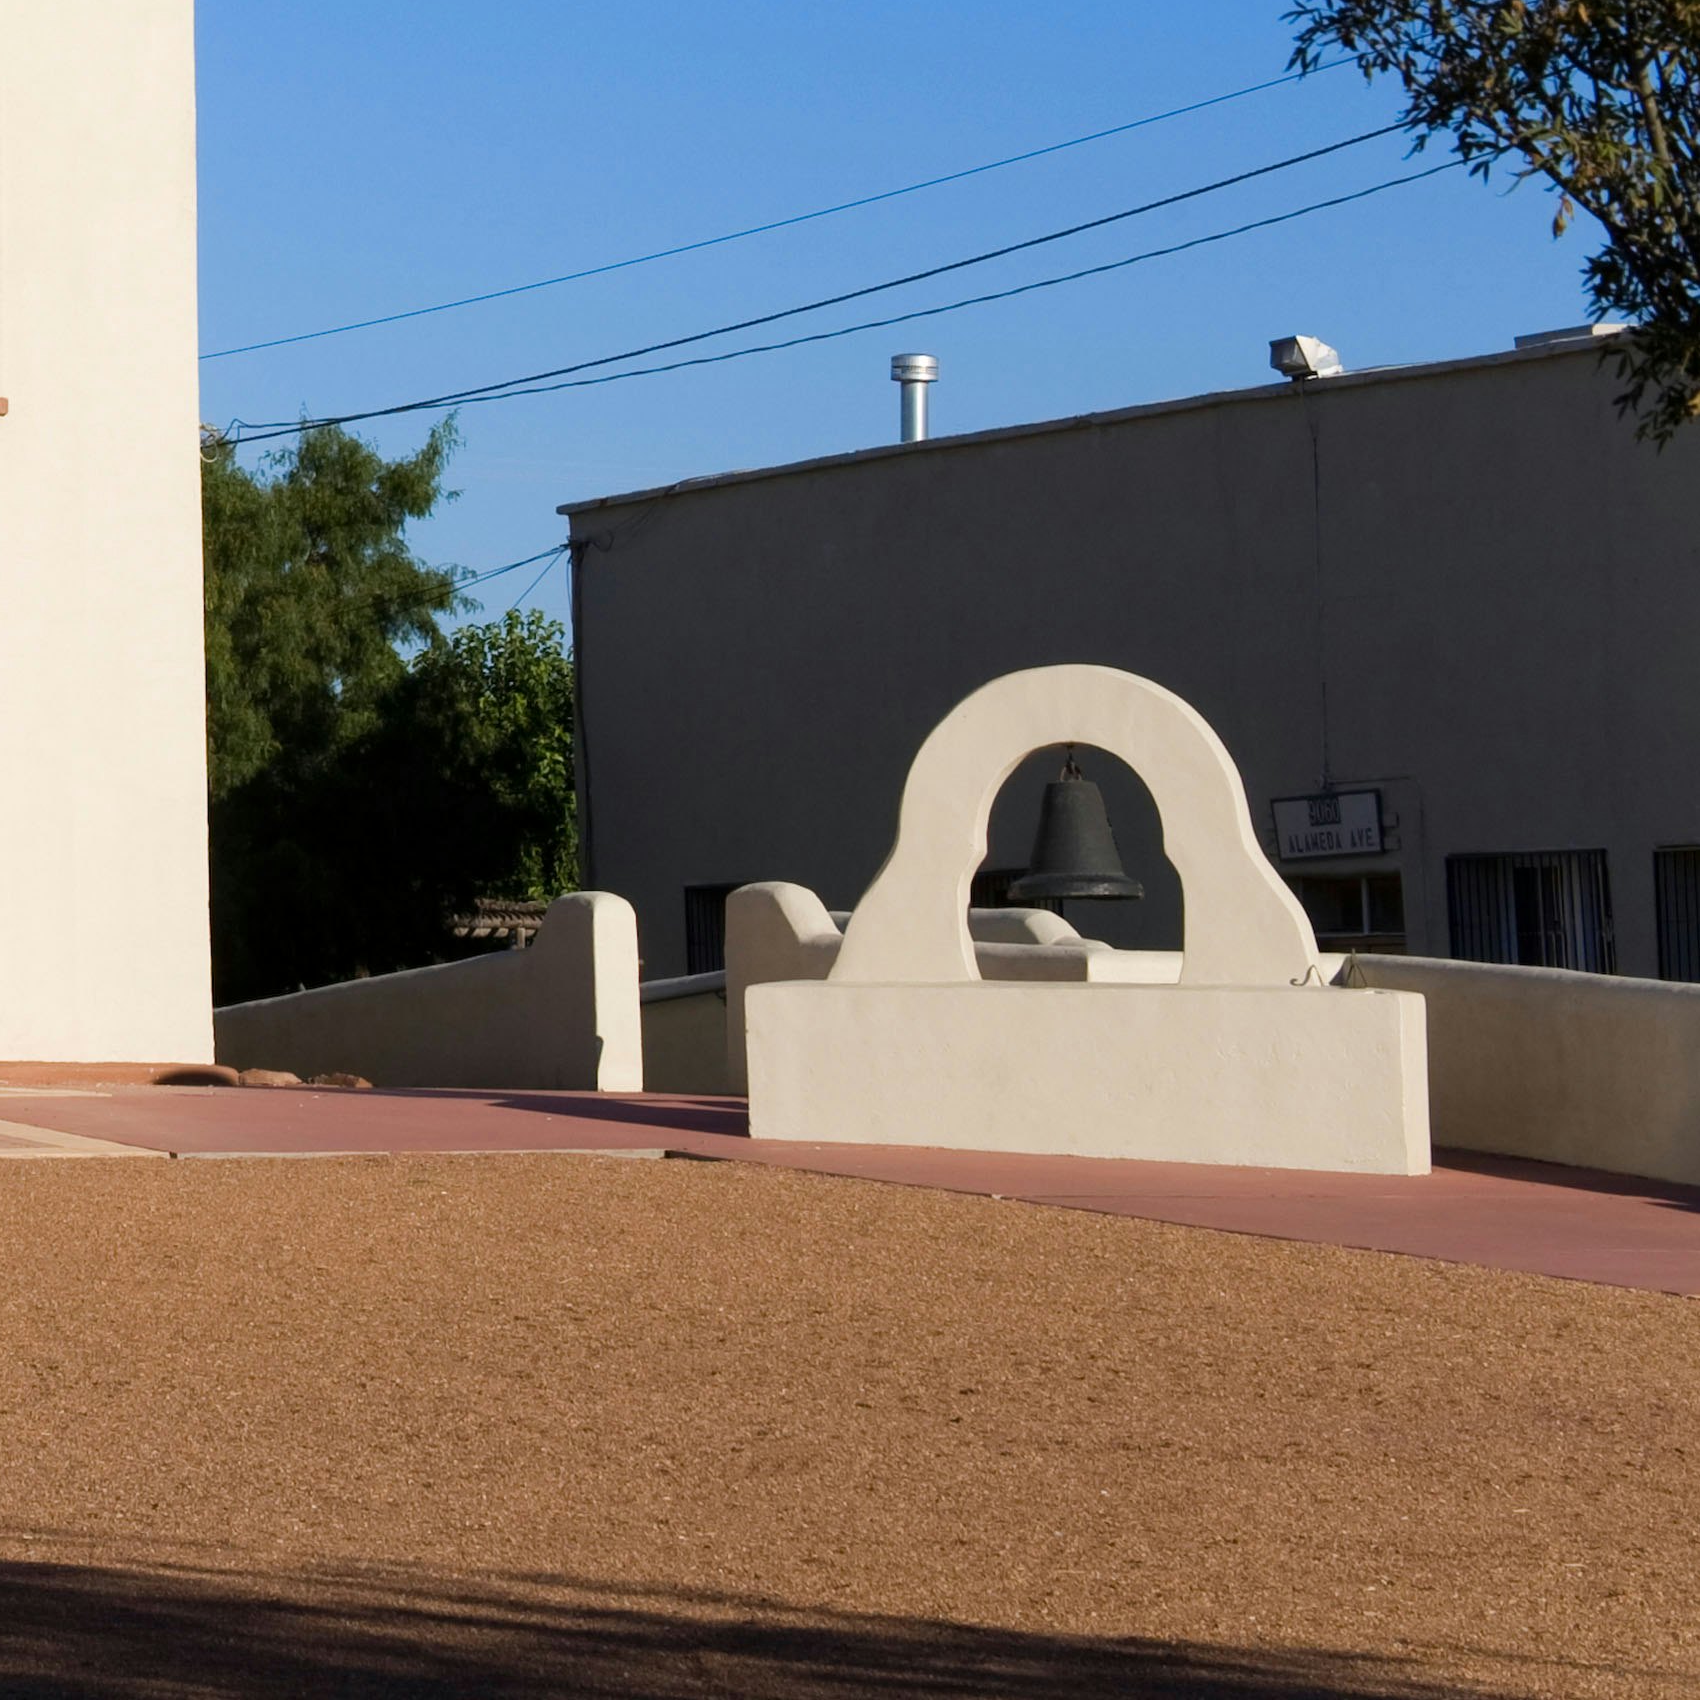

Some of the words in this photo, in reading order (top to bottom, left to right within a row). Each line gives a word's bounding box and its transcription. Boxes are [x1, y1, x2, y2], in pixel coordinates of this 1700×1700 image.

[1309, 800, 1340, 823] 9060
[1289, 831, 1342, 854] ALAMEDA
[1350, 827, 1375, 849] AVE
